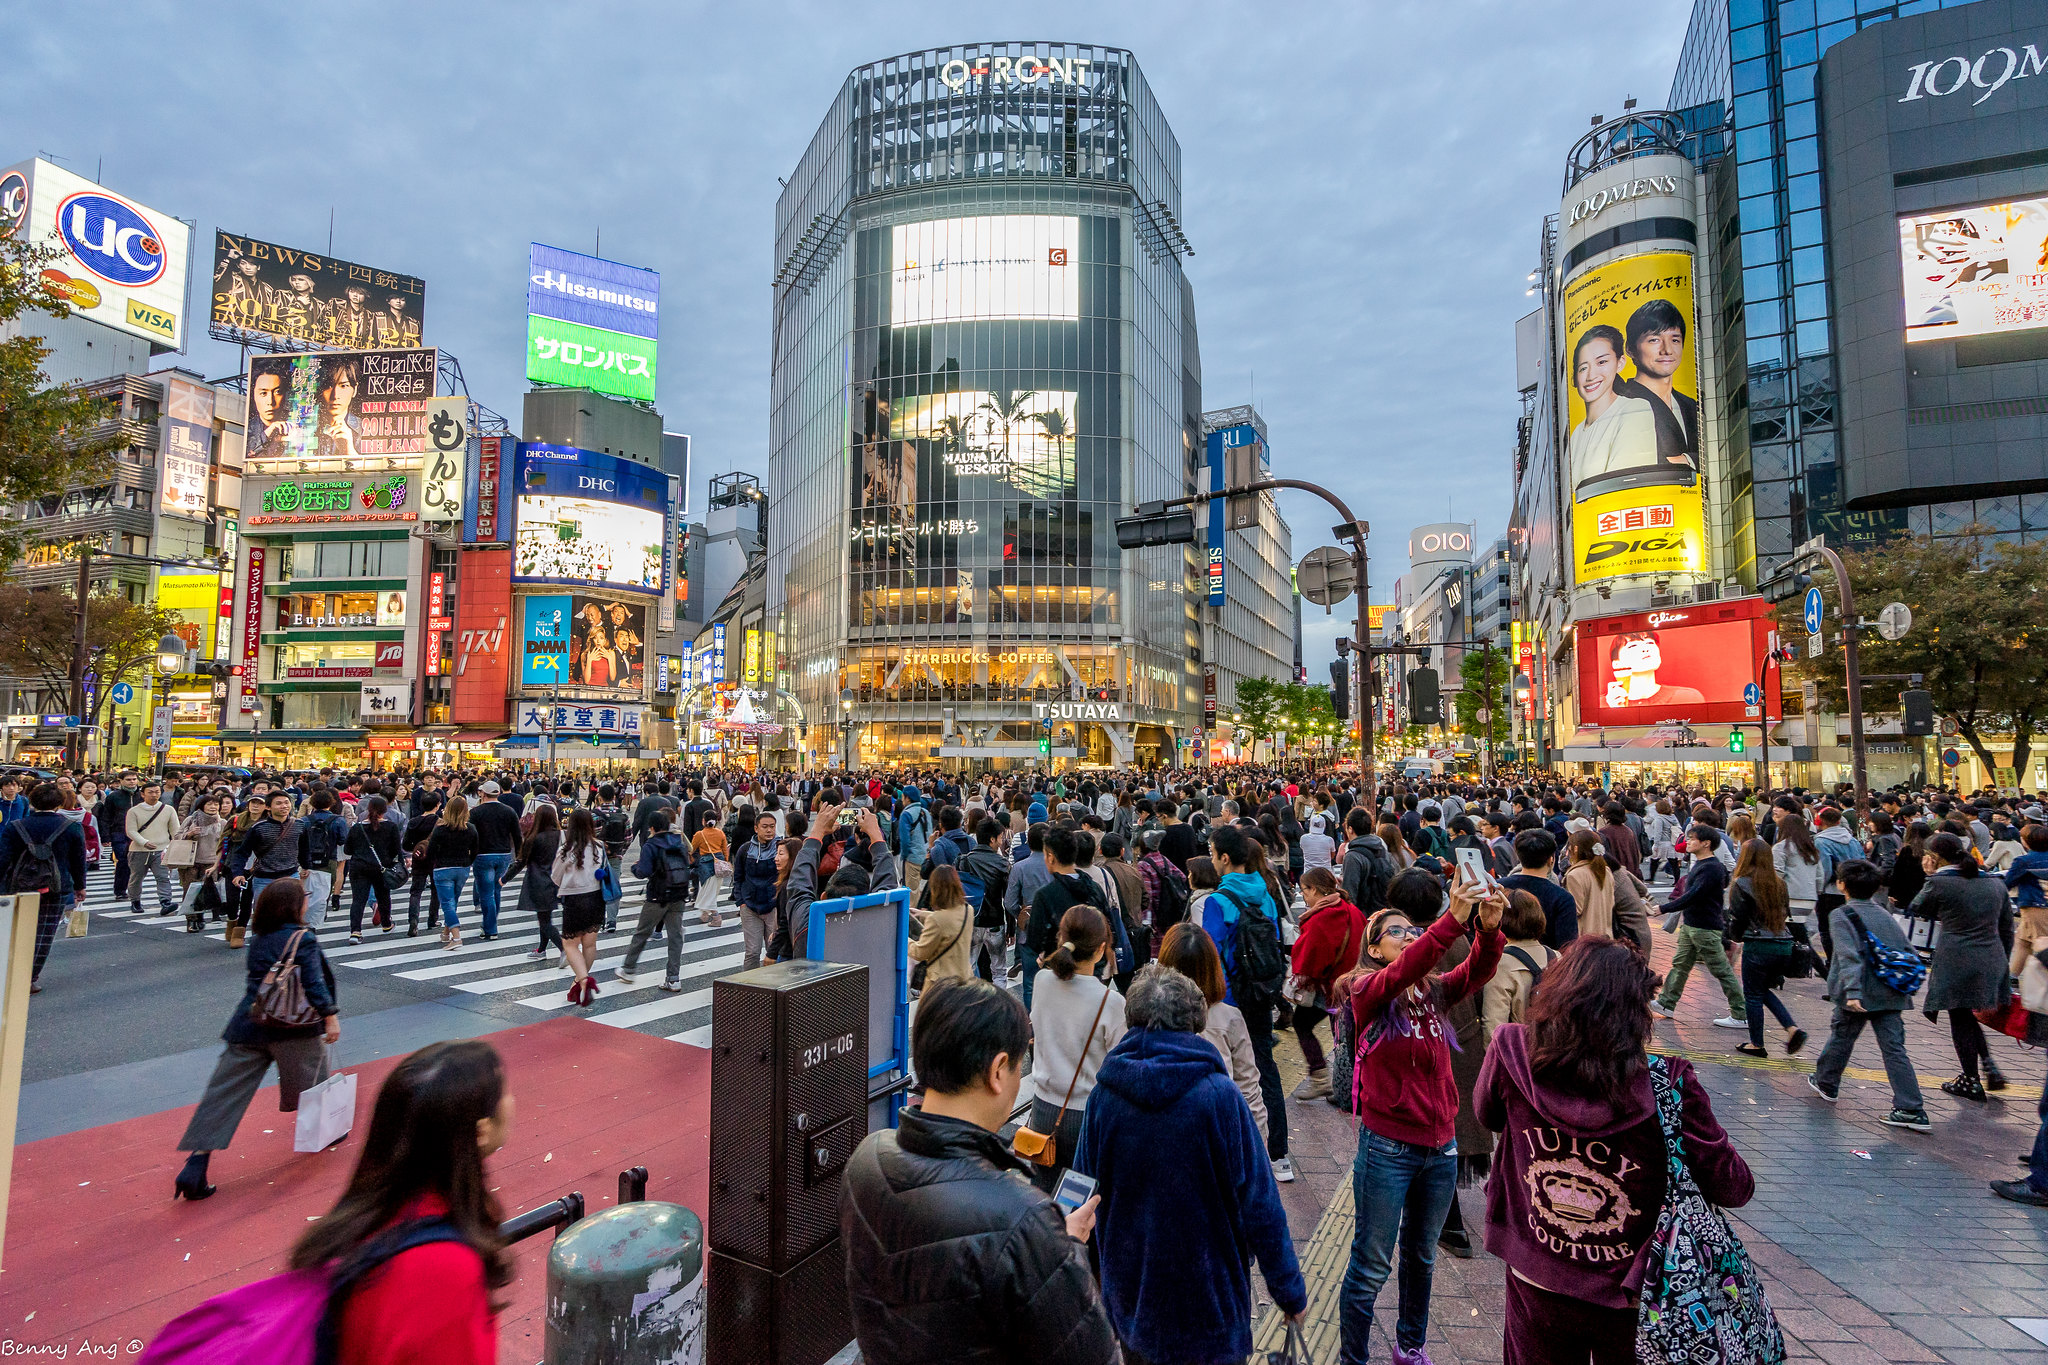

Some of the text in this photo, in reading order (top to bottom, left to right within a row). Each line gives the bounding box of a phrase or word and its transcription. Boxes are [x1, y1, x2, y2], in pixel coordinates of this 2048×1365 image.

[941, 56, 1090, 94] QFRONT
[72, 203, 157, 272] UC
[219, 234, 322, 272] NEWS
[349, 264, 424, 297] 四銃士
[531, 270, 656, 313] Hisamitsu
[1567, 276, 1602, 300] Panasonic
[132, 308, 174, 332] VISA
[362, 353, 434, 375] KinKi
[534, 335, 651, 378] サロンパス
[367, 375, 426, 396] Kids
[361, 401, 386, 413] NEW
[424, 408, 465, 518] もんじゃ
[525, 451, 578, 461] DHC Channel
[955, 463, 1011, 475] RESORT
[477, 440, 497, 536] 三千里薬品
[578, 475, 615, 492] DHC
[184, 492, 205, 507] 地下
[302, 490, 352, 511] 西村
[1599, 507, 1672, 533] 全自動
[1584, 538, 1688, 565] DIGA
[1210, 547, 1222, 596] SEIBU
[1446, 580, 1462, 608] ZAR
[294, 614, 373, 627] Euphoria
[378, 646, 403, 662] JTB
[526, 640, 567, 653] DMM
[903, 652, 1054, 665] STARBUCKS COFFEE
[532, 655, 560, 669] FX
[524, 707, 639, 730] 大盛堂書店
[1036, 703, 1120, 719] TSUTAYA
[803, 1032, 854, 1069] 331-06
[1522, 1127, 1641, 1182] JUICY
[1528, 1213, 1634, 1262] COUTURE
